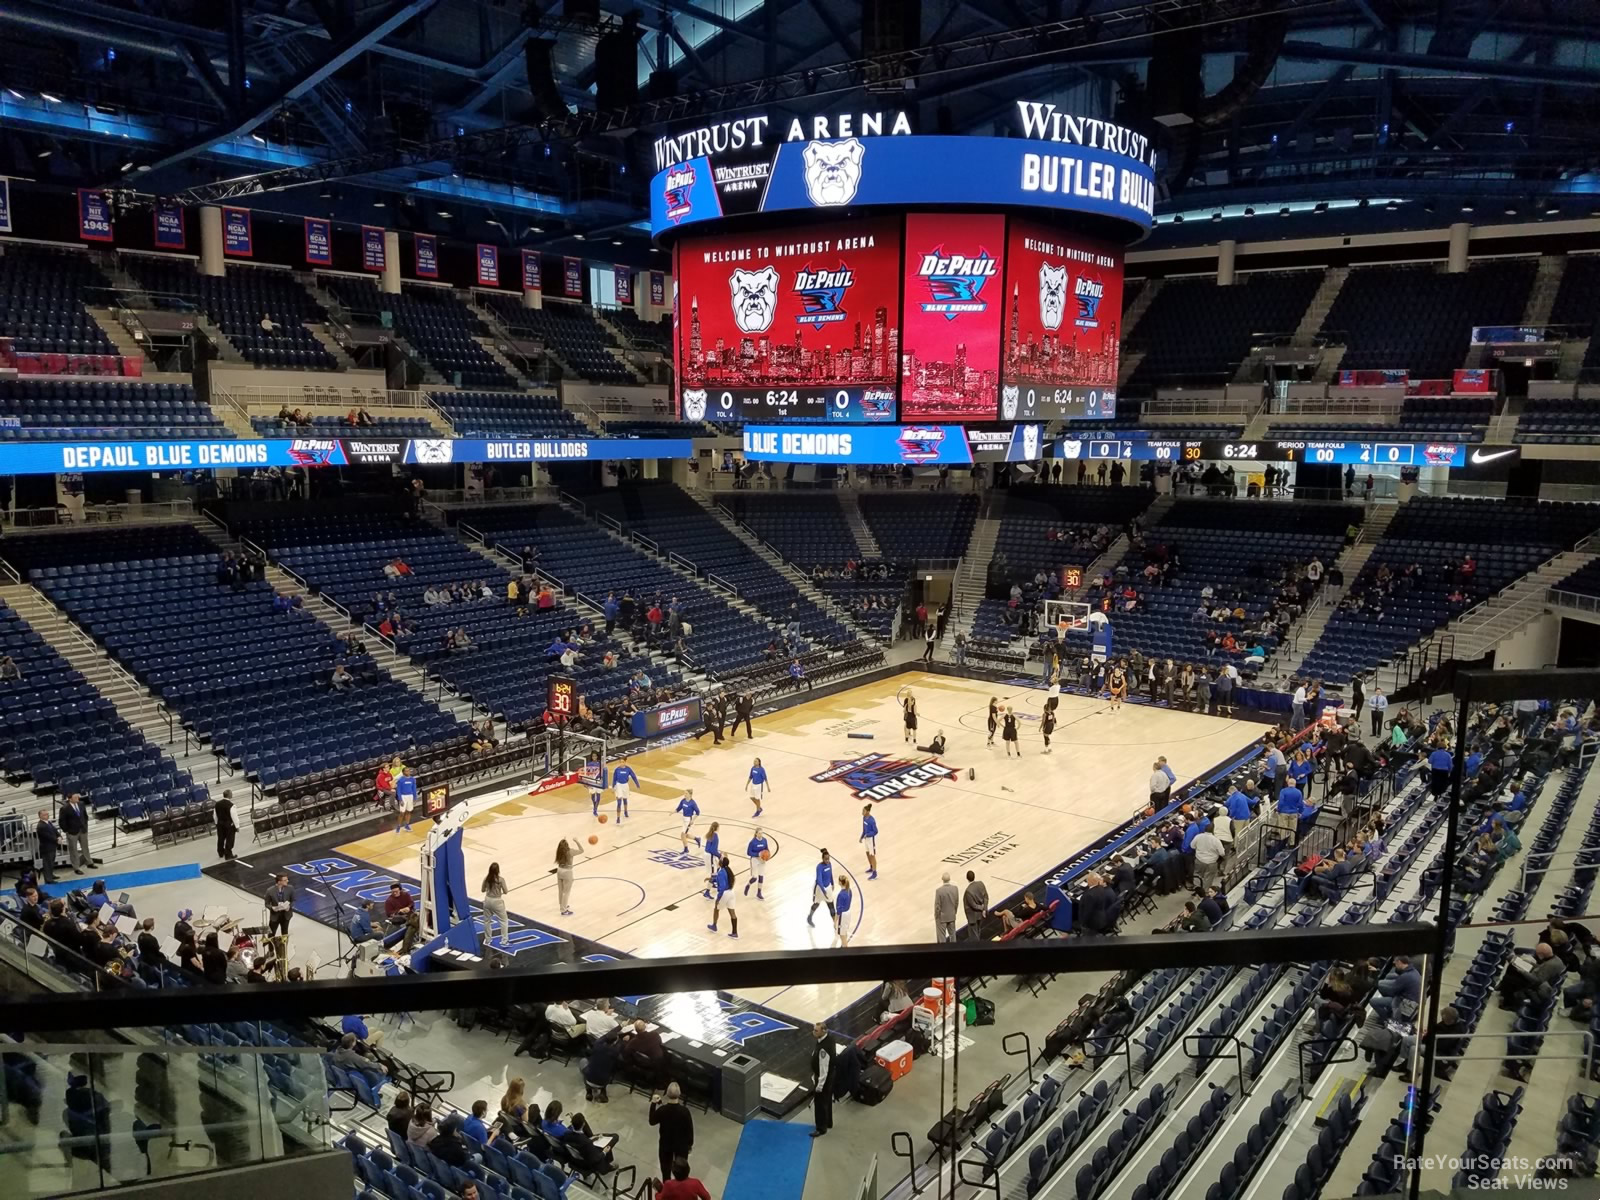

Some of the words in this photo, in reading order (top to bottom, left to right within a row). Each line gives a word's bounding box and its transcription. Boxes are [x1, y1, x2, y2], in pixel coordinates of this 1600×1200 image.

[1017, 100, 1148, 163] WINTRUST
[655, 115, 769, 172] WINTRUST
[787, 112, 912, 142] ARENA
[715, 163, 769, 180] WINTRUST
[1021, 153, 1115, 201] BUTLER
[724, 181, 758, 192] ARENA
[84, 220, 109, 231] 1945
[703, 249, 751, 264] WELCOME
[758, 247, 769, 258] TO
[776, 241, 831, 257] WINTRUST
[837, 235, 875, 250] ARENA
[1024, 237, 1054, 256] WELCOME
[1057, 248, 1064, 256] TO
[1066, 248, 1095, 265] WINTRUST
[1096, 252, 1114, 268] ARENA
[918, 255, 998, 276] DEPAUL
[618, 280, 627, 288] 24
[794, 270, 854, 291] DEPAUL
[653, 284, 662, 293] 99
[1075, 279, 1104, 297] DEPAUL
[799, 315, 816, 323] BLUE
[818, 313, 845, 322] DEMONS
[721, 392, 733, 410] 0
[766, 390, 798, 405] 6:24
[836, 390, 849, 410] 0
[1027, 389, 1035, 408] 0
[1054, 389, 1072, 404] 6:24
[1089, 391, 1096, 408] 0
[903, 428, 944, 440] DEPAUL
[968, 430, 1011, 441] WINTRUST
[293, 439, 336, 450] DEPAUL
[351, 442, 400, 452] WINTRUST
[752, 432, 778, 453] BLUE
[782, 433, 852, 455] DEMONS
[977, 443, 1004, 451] ARENA
[1100, 444, 1109, 456] 0
[63, 446, 139, 468] DEPAUL
[146, 444, 192, 466] BLUE
[199, 444, 267, 465] DEMONS
[487, 443, 531, 459] BUTLER
[534, 442, 588, 458] BULLDOGS
[1123, 447, 1132, 458] 4
[1156, 447, 1170, 459] 00
[1186, 448, 1201, 459] 30
[1224, 445, 1257, 458] 6:24
[1288, 450, 1293, 460] 1
[1316, 449, 1334, 462] 00
[1360, 449, 1369, 462] 4
[1388, 448, 1399, 461] 0
[361, 454, 391, 462] ARENA
[1067, 576, 1078, 586] 30
[554, 693, 569, 711] 30
[660, 708, 688, 723] DEPAUL
[854, 754, 879, 765] BLUE
[815, 764, 854, 781] DEMONS
[859, 762, 952, 800] DEPAUL
[431, 799, 442, 810] 30
[941, 831, 1010, 864] WINTRUST
[981, 843, 1020, 864] ARENA
